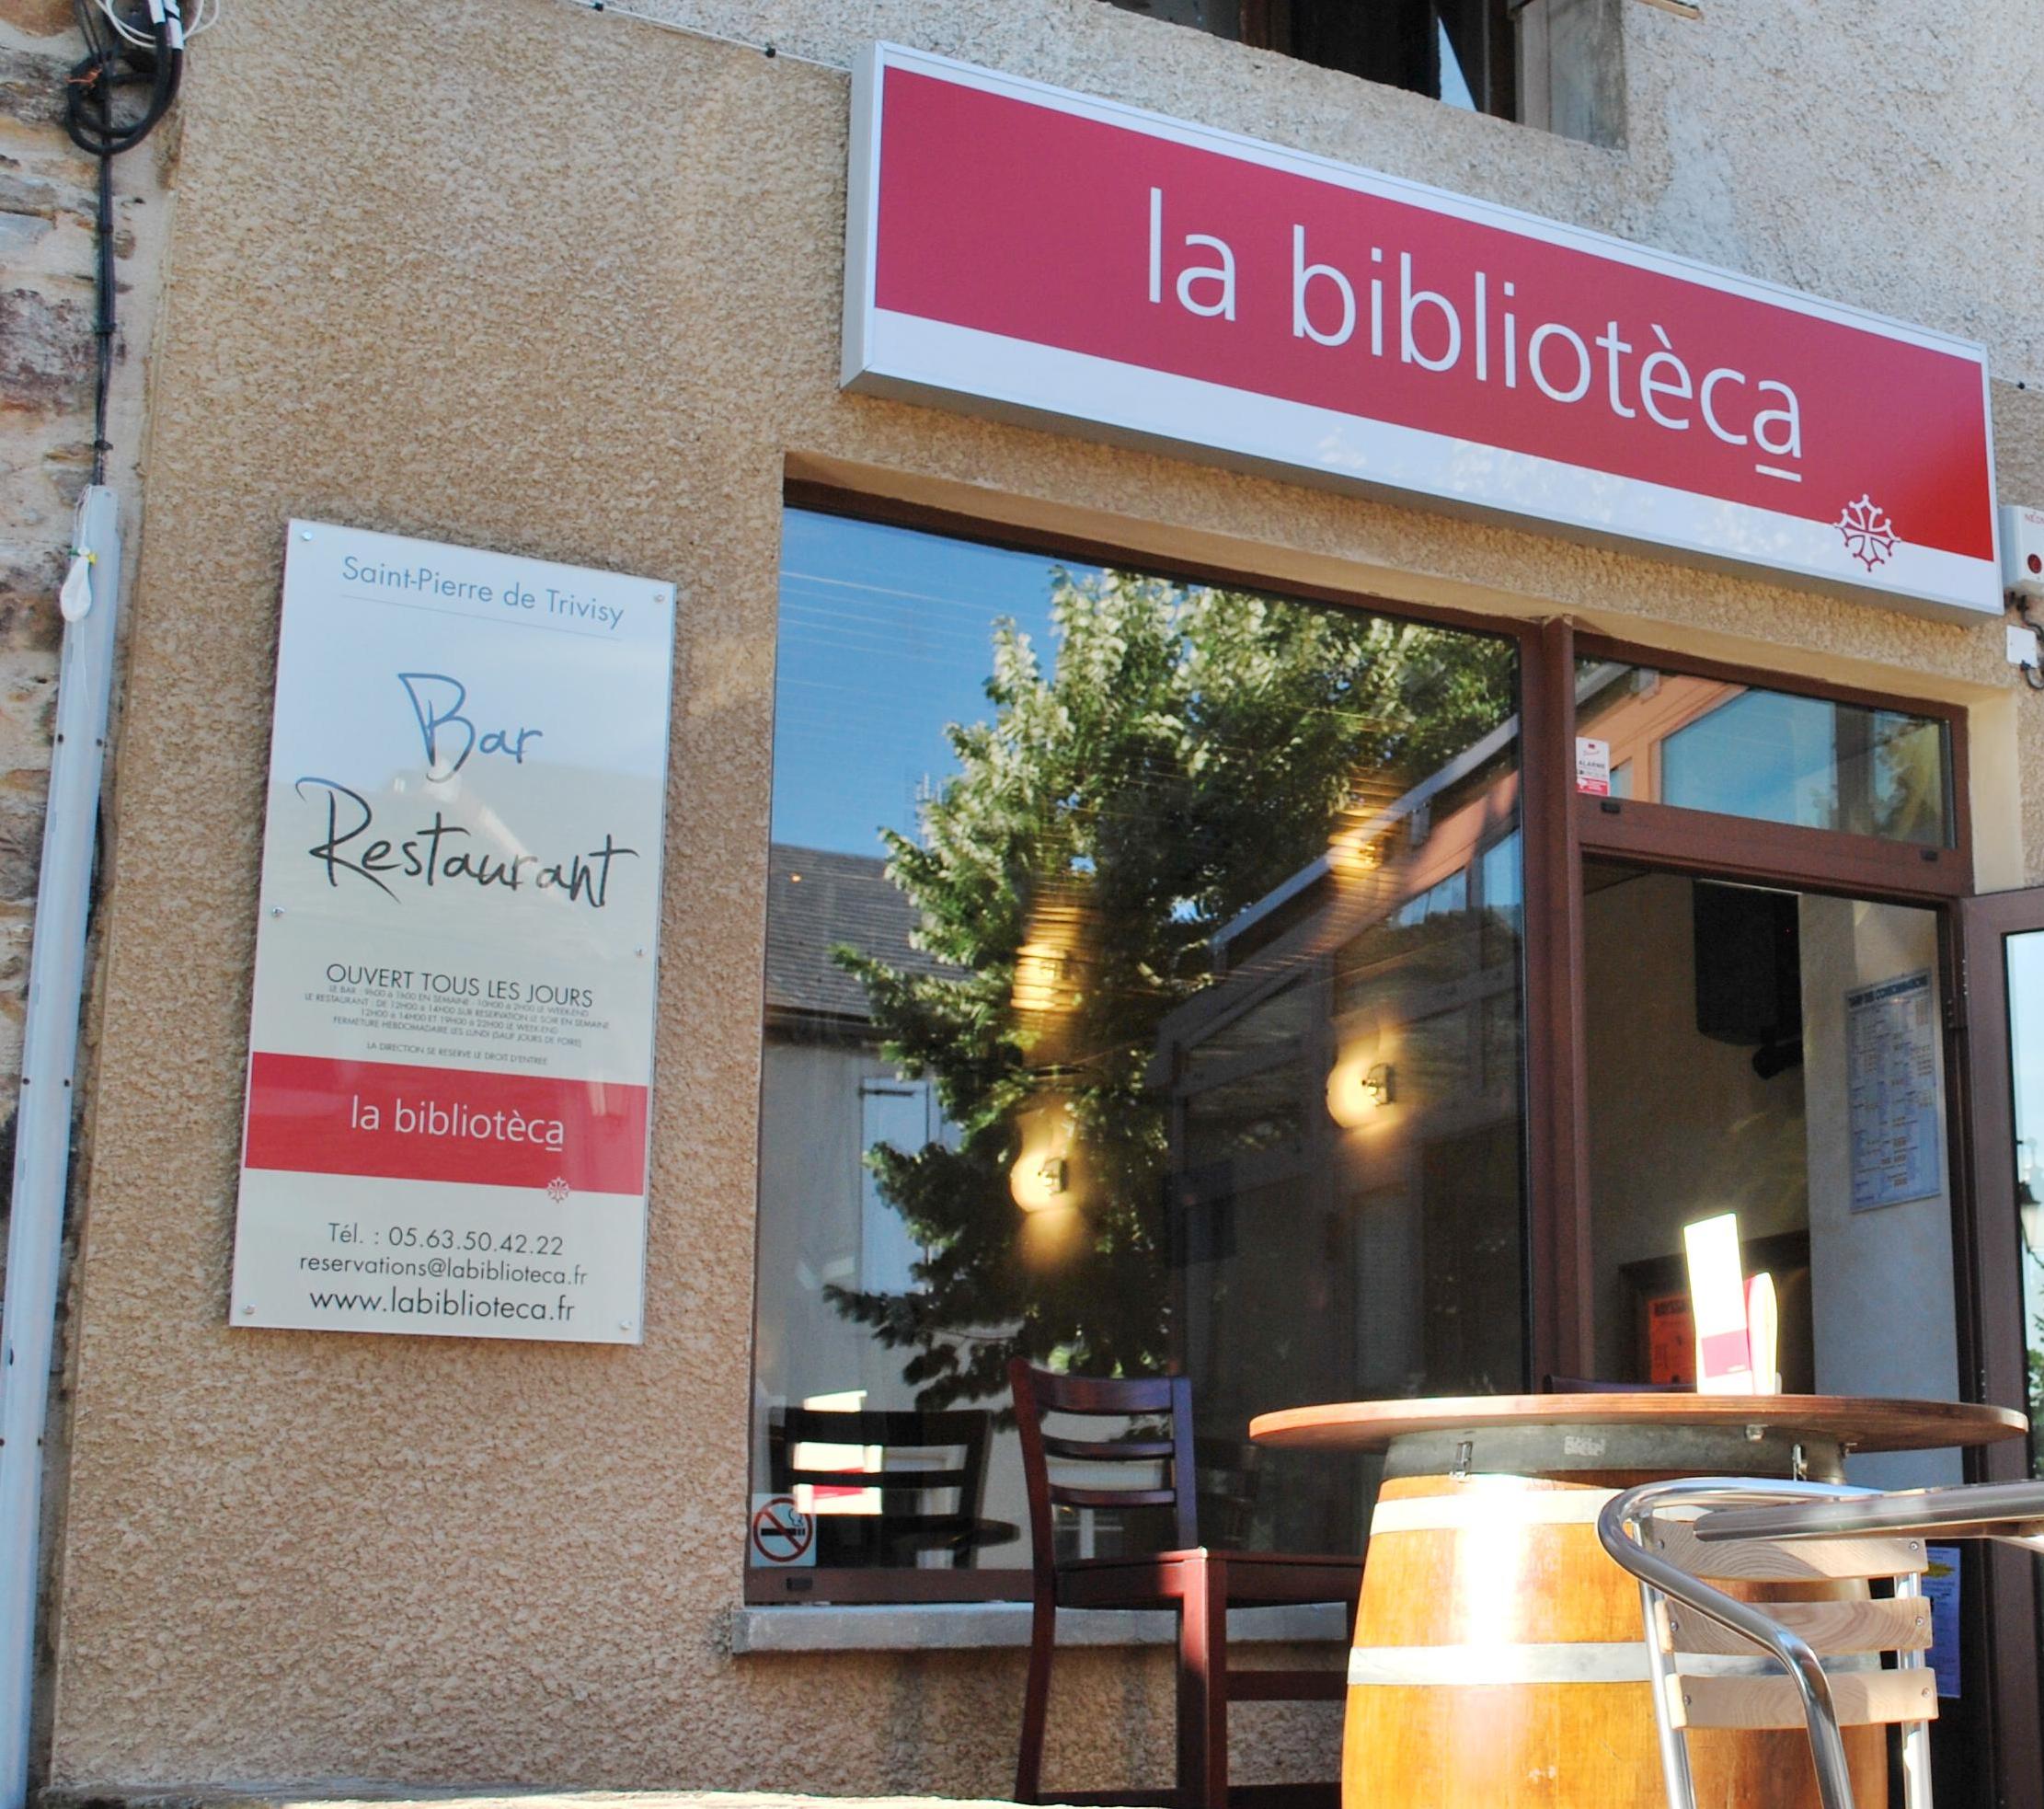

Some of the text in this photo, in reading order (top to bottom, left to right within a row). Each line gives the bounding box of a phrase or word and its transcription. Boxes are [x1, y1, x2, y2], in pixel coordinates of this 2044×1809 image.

[1149, 187, 1803, 462] la bibliotèca
[342, 555, 625, 630] Saint-Pierre de Trivisy
[397, 672, 544, 783] Bar
[295, 776, 639, 908] Restaurant
[316, 994, 369, 1006] RESTAURANT
[327, 963, 592, 1008] OUVERT TOUS LES JOURS
[350, 1094, 564, 1146] la bibliotèca
[328, 1222, 364, 1245] Tél.
[389, 1226, 564, 1256] 05.63.50.42.22
[300, 1254, 589, 1286] reservations@labiblioteca.fr
[310, 1286, 575, 1321] www.labiblioteca.fr
